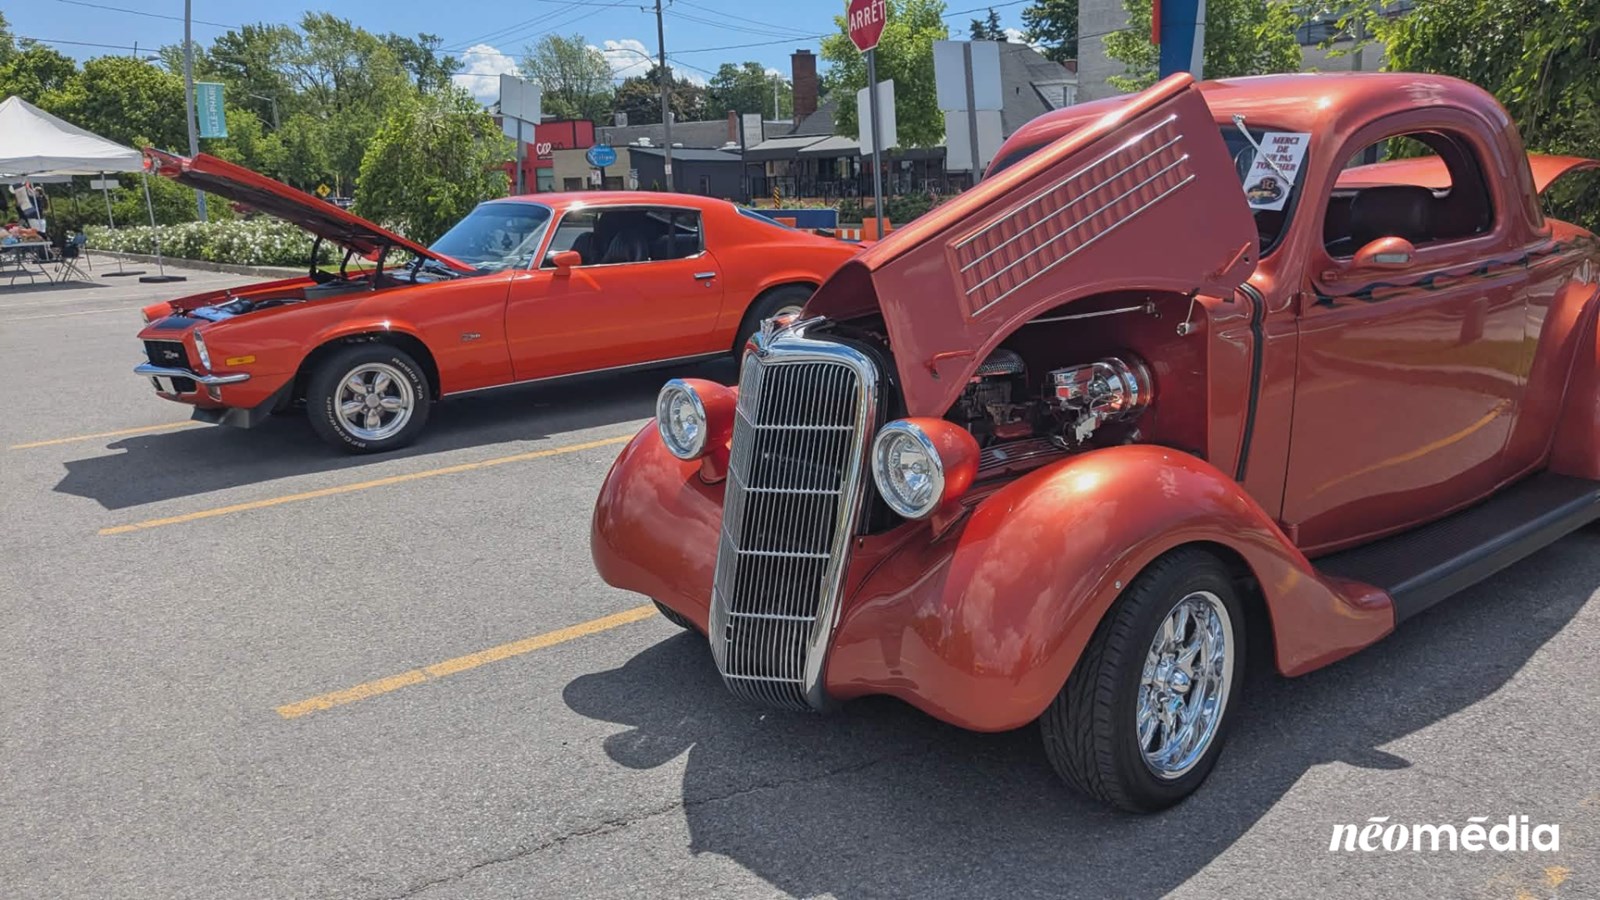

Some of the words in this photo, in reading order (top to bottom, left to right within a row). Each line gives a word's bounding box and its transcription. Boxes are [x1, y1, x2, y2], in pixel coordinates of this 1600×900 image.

[850, 0, 884, 32] ARRÊT
[1272, 136, 1299, 144] MERCI
[1276, 145, 1290, 153] DE
[1278, 154, 1293, 162] PAS
[391, 357, 419, 383] Radial
